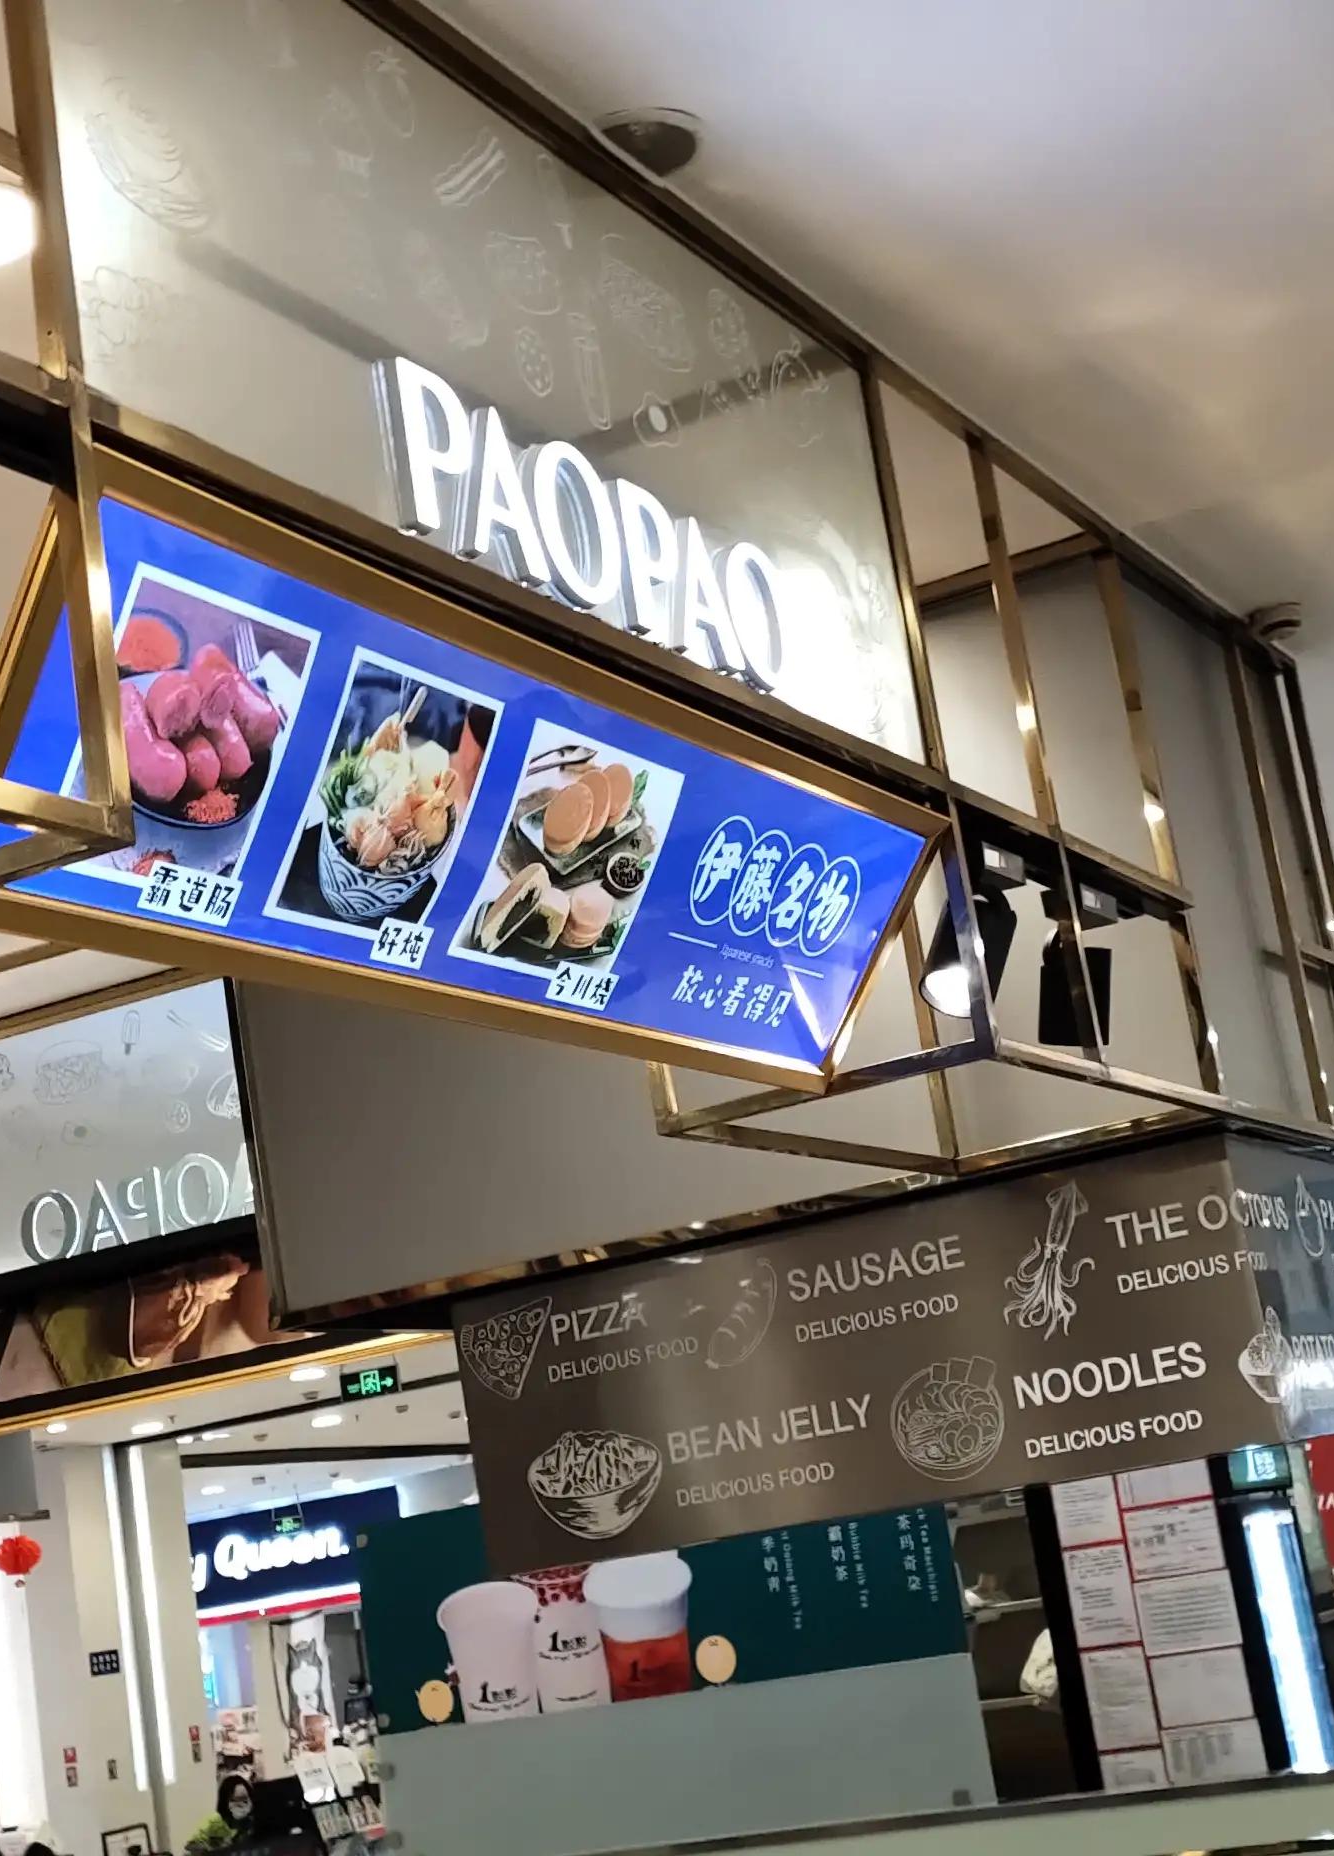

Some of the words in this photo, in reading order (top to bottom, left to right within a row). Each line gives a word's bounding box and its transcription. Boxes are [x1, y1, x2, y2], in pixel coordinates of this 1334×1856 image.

[387, 356, 785, 690] PAOPAO
[142, 865, 233, 920] 霸道肠
[692, 829, 851, 943] 伊藤名物
[375, 926, 424, 965] 好炖
[553, 966, 615, 1005] 今川烧
[670, 964, 794, 1028] 放心看得见
[1104, 1202, 1189, 1249] THE
[1197, 1188, 1290, 1231] OCTOPUS
[787, 1234, 965, 1302] SAUSAGE
[1117, 1253, 1231, 1294] DELICIOUS
[550, 1301, 649, 1347] PIZZA
[794, 1306, 897, 1343] DELICIOUS
[900, 1293, 959, 1322] FOOD
[547, 1347, 642, 1384] DELICIOUS
[646, 1335, 699, 1363] FOOD
[1013, 1341, 1207, 1409] NOODLES
[667, 1416, 763, 1465] BEAN
[772, 1393, 871, 1445] JELLY
[1025, 1421, 1136, 1459] DELICIOUS
[1139, 1409, 1203, 1439] FOOD
[676, 1472, 775, 1507] DELICIOUS
[778, 1462, 835, 1489] FOOD
